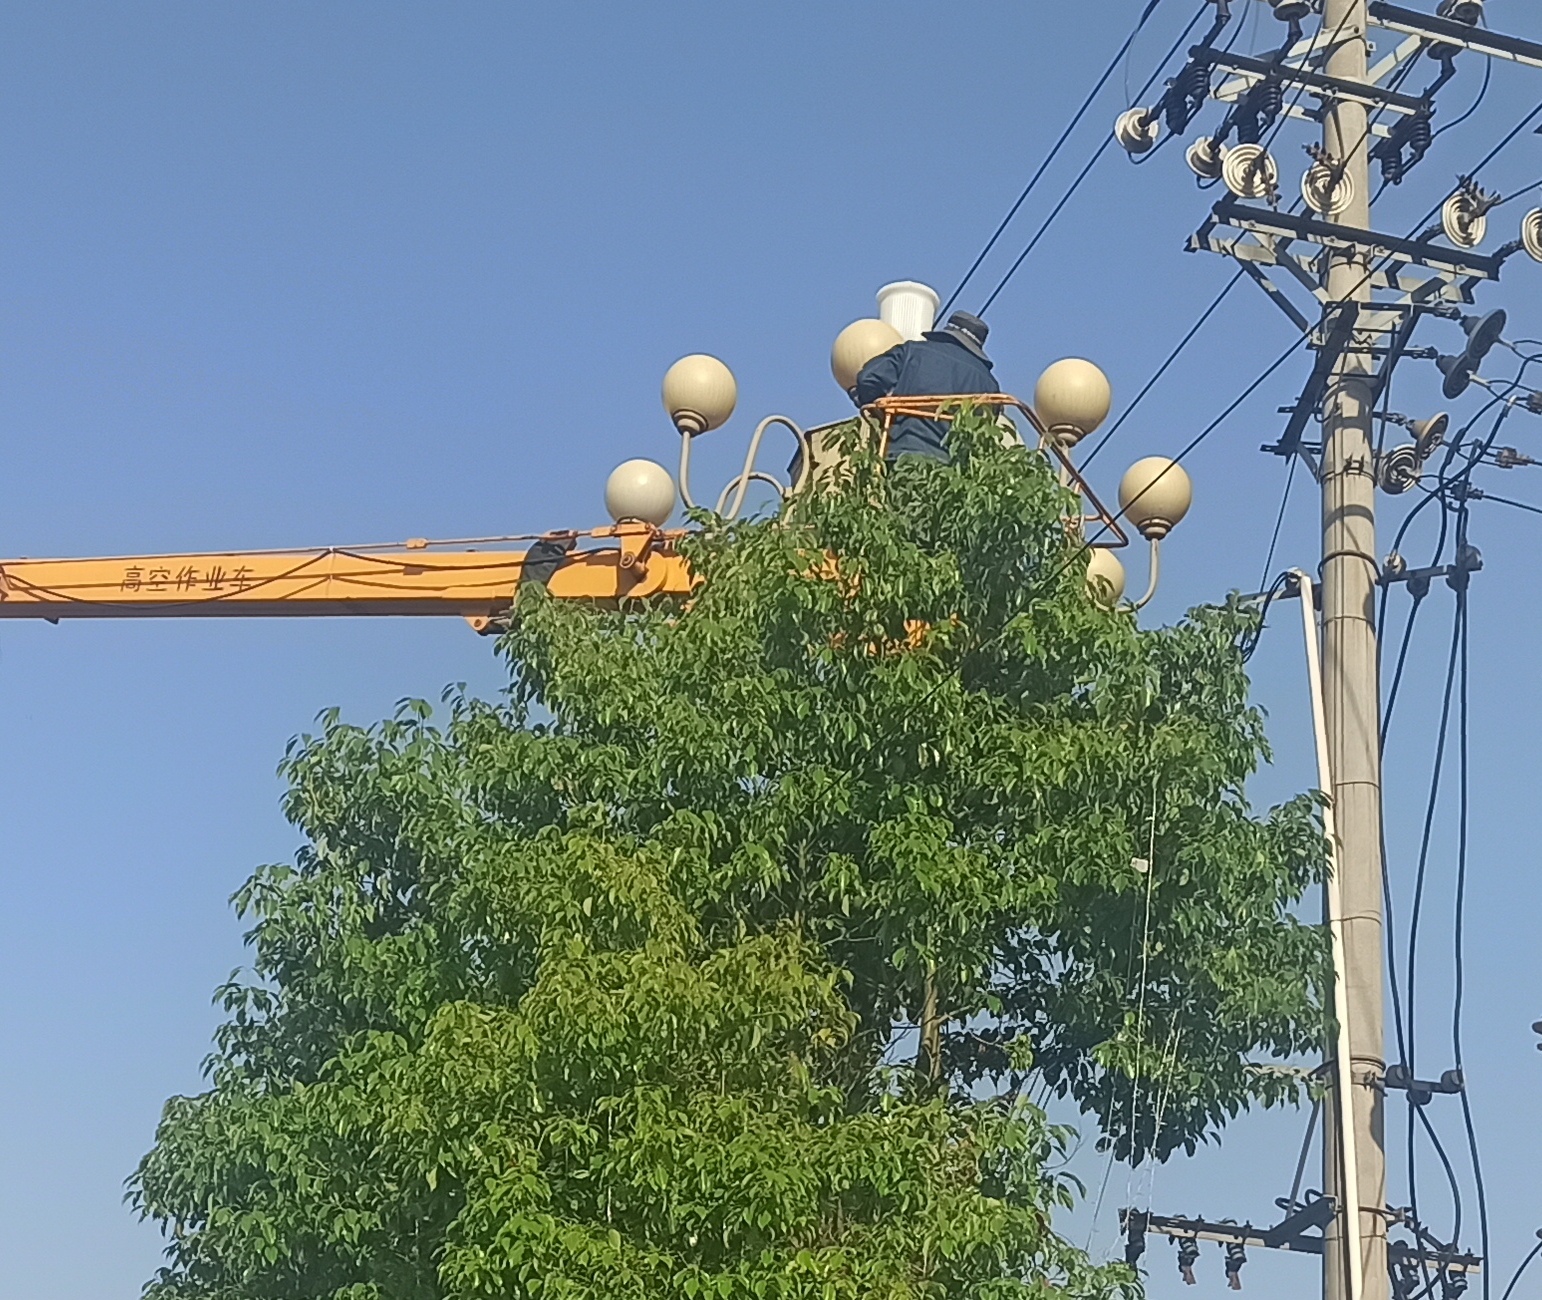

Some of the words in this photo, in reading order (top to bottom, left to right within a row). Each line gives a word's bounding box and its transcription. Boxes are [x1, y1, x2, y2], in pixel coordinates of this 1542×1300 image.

[120, 565, 254, 592] 高空作业车
